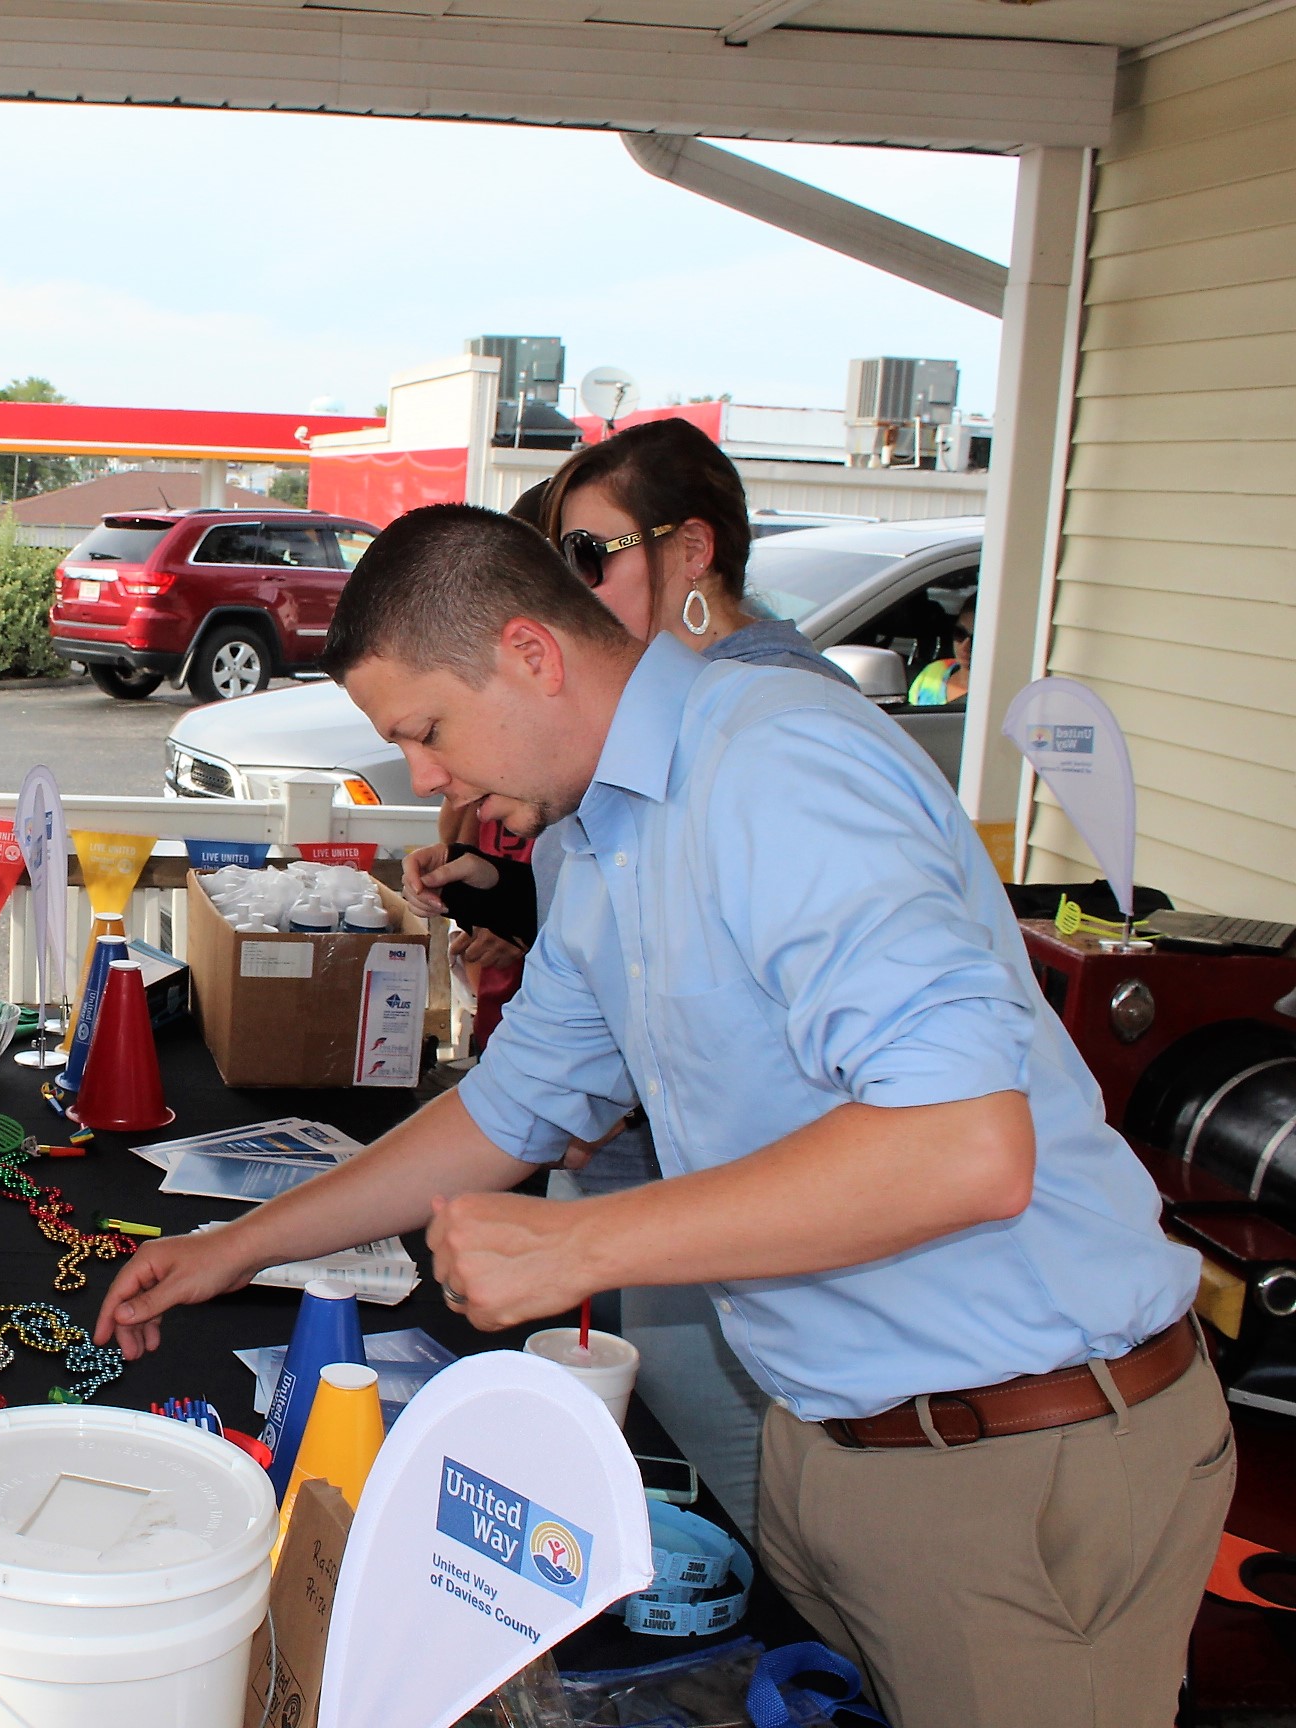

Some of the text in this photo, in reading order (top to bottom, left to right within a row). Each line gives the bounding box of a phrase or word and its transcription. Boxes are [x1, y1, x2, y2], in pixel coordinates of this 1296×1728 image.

[108, 845, 136, 856] UNITED
[313, 848, 359, 858] LIVE UNITED
[202, 852, 249, 864] LIVE UNITED
[85, 992, 96, 1021] United
[393, 1000, 411, 1009] PLUS
[273, 1375, 292, 1422] United
[445, 1466, 522, 1531] United
[472, 1510, 519, 1563] Way
[687, 1561, 706, 1573] ONE
[432, 1552, 498, 1601] United Way
[680, 1571, 708, 1583] ADMIT
[430, 1572, 541, 1645] of Daviess County
[649, 1608, 671, 1620] ONE
[712, 1604, 729, 1617] ONE
[642, 1618, 677, 1631] ADMIT
[707, 1613, 731, 1628] ADMIT
[266, 1647, 291, 1695] Uited
